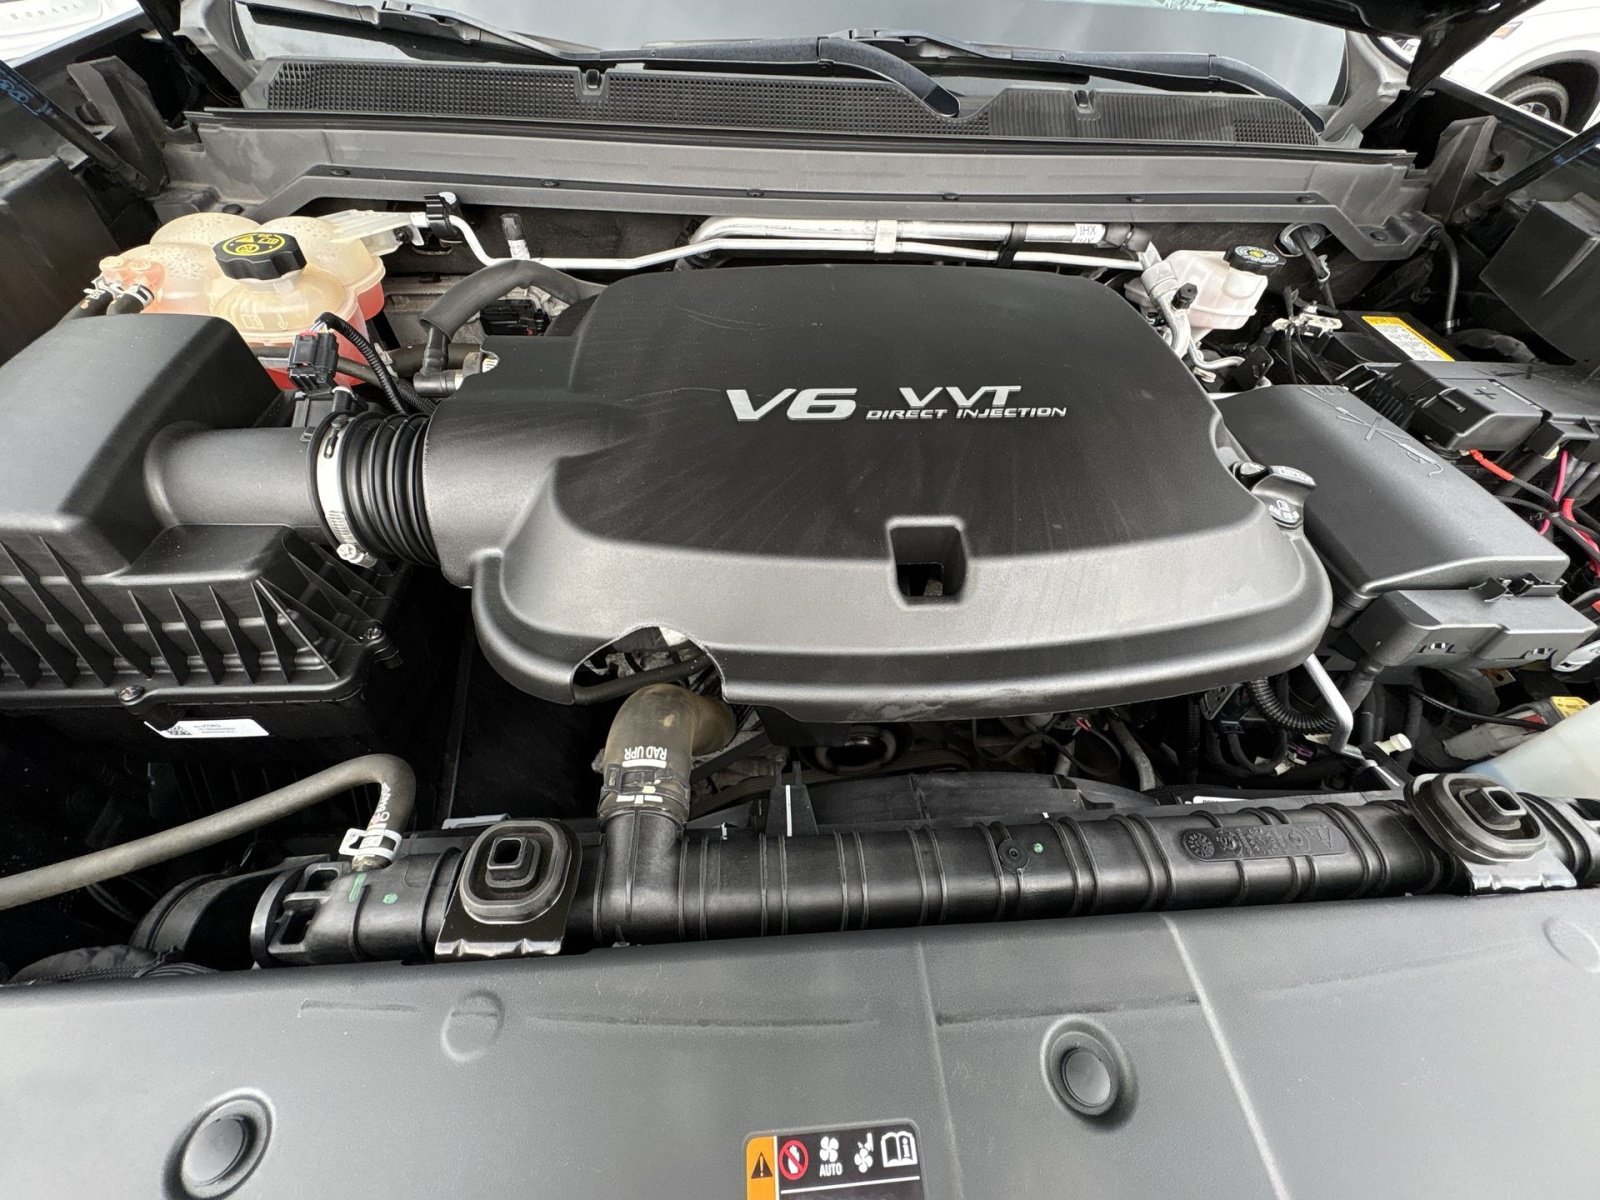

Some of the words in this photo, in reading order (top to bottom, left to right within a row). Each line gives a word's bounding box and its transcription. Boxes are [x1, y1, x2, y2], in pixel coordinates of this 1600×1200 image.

[899, 385, 1021, 408] VVT
[726, 388, 857, 421] V6
[865, 409, 948, 420] DIRECT
[956, 407, 1066, 419] INJECTION
[624, 746, 644, 760] UPR
[645, 746, 667, 760] RAD
[819, 1162, 843, 1178] AUTO
